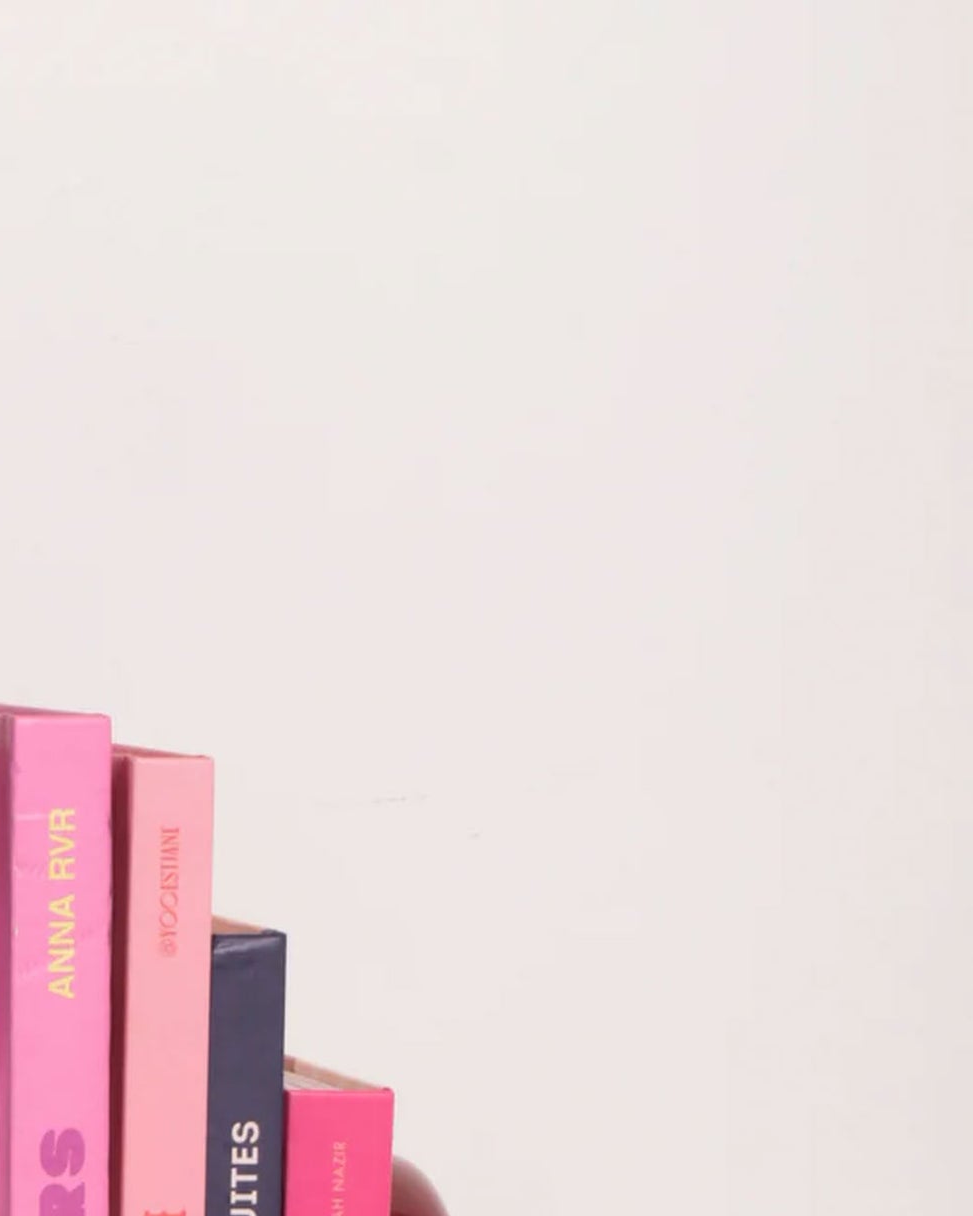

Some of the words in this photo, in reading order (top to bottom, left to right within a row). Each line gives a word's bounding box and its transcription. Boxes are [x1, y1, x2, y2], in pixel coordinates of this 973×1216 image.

[47, 808, 76, 880] RVR
[47, 894, 76, 998] ANNA
[332, 1142, 346, 1190] NAZIR
